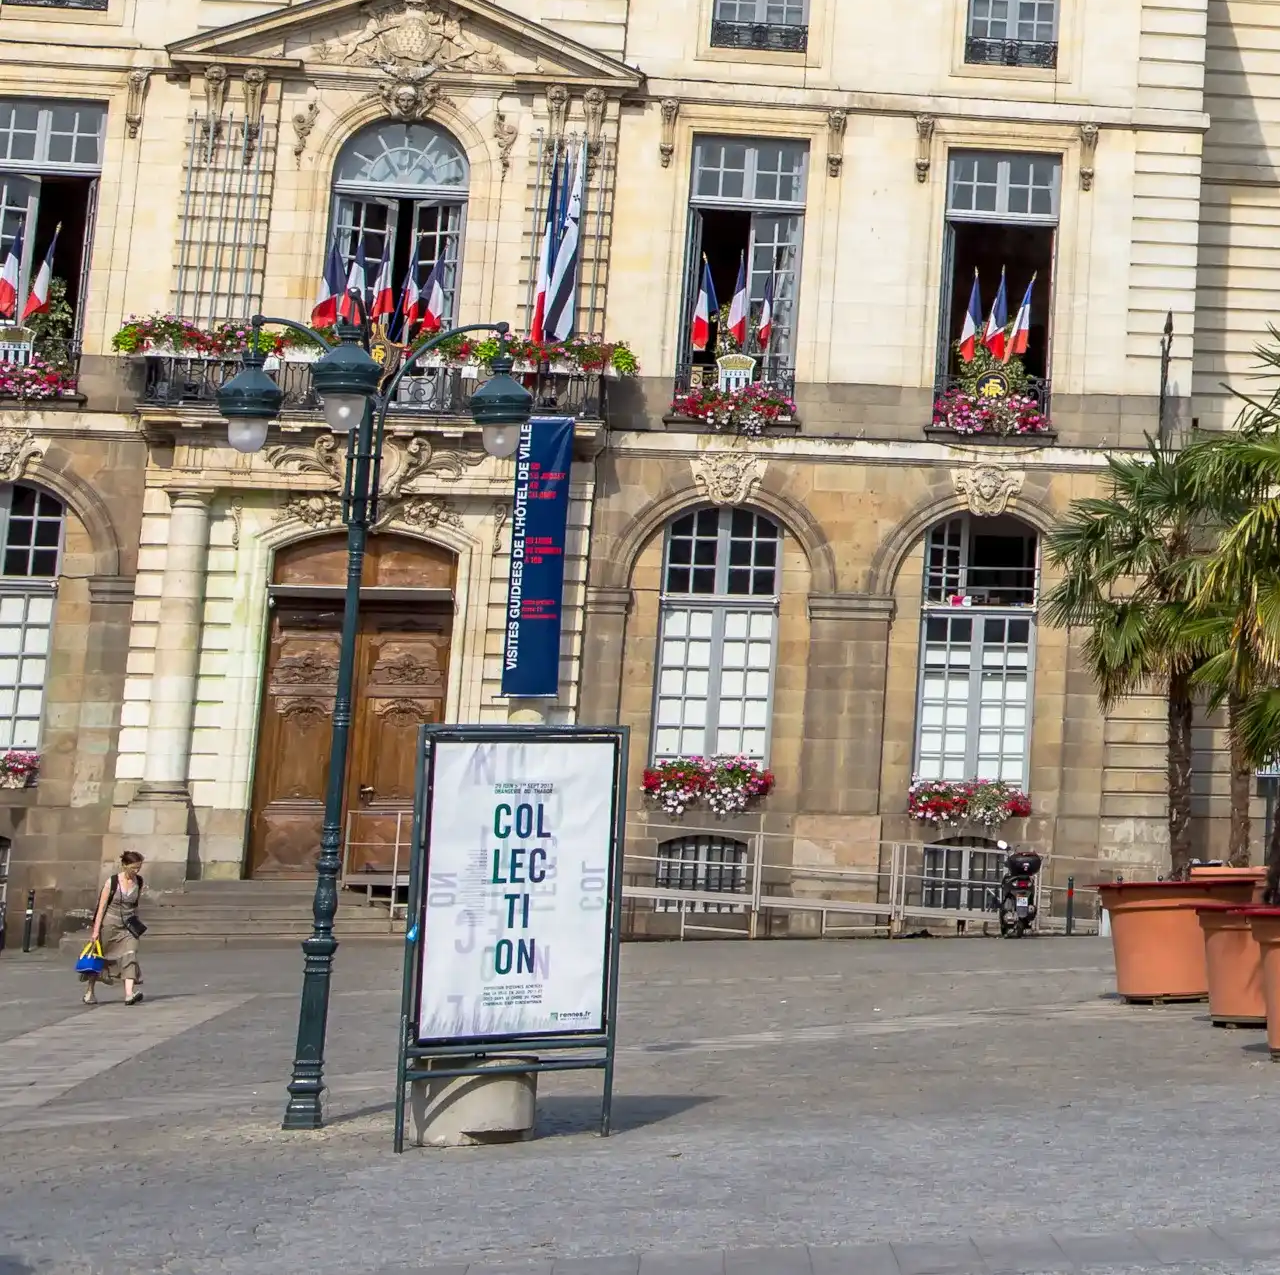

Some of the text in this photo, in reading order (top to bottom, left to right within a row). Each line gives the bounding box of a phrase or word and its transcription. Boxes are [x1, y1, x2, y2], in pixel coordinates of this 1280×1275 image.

[506, 423, 533, 671] VISITES GUIDEES DE L'HÔTEL DE VILLE
[494, 803, 551, 839] COL
[492, 848, 546, 884] LEC
[504, 893, 530, 929] TI
[495, 938, 536, 975] ON
